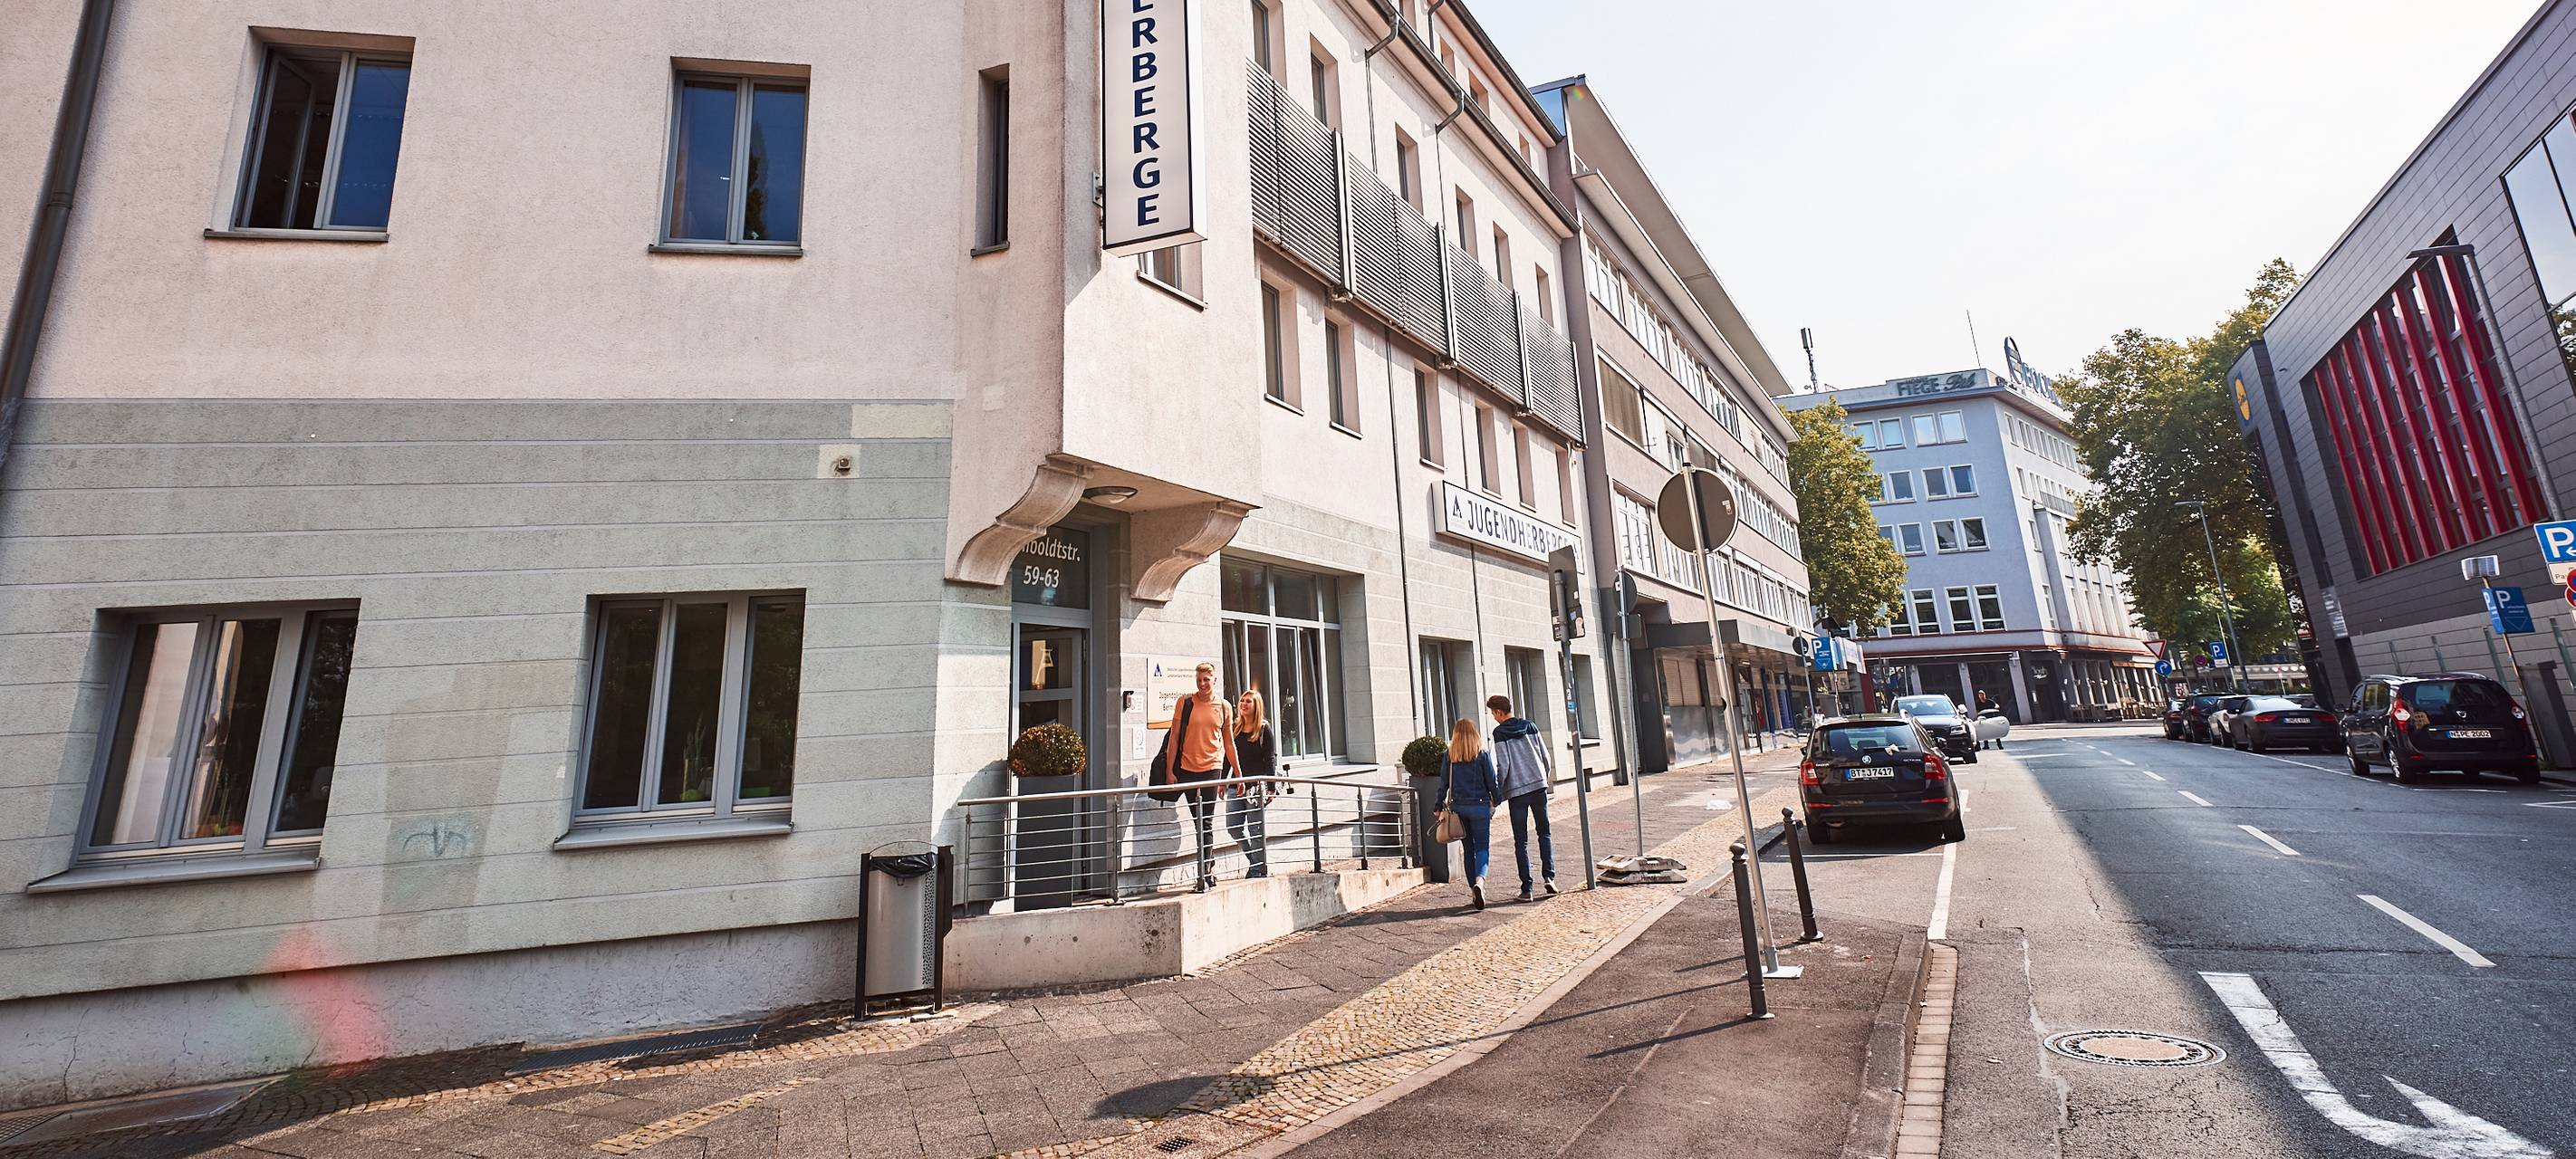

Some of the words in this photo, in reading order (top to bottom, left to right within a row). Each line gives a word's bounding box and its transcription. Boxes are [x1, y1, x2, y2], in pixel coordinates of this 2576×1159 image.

[1897, 378, 1940, 396] FIEGE
[2544, 527, 2574, 558] P
[1023, 565, 1060, 588] 59-63
[2495, 590, 2511, 608] P
[1812, 640, 1822, 654] P
[2212, 645, 2220, 657] P
